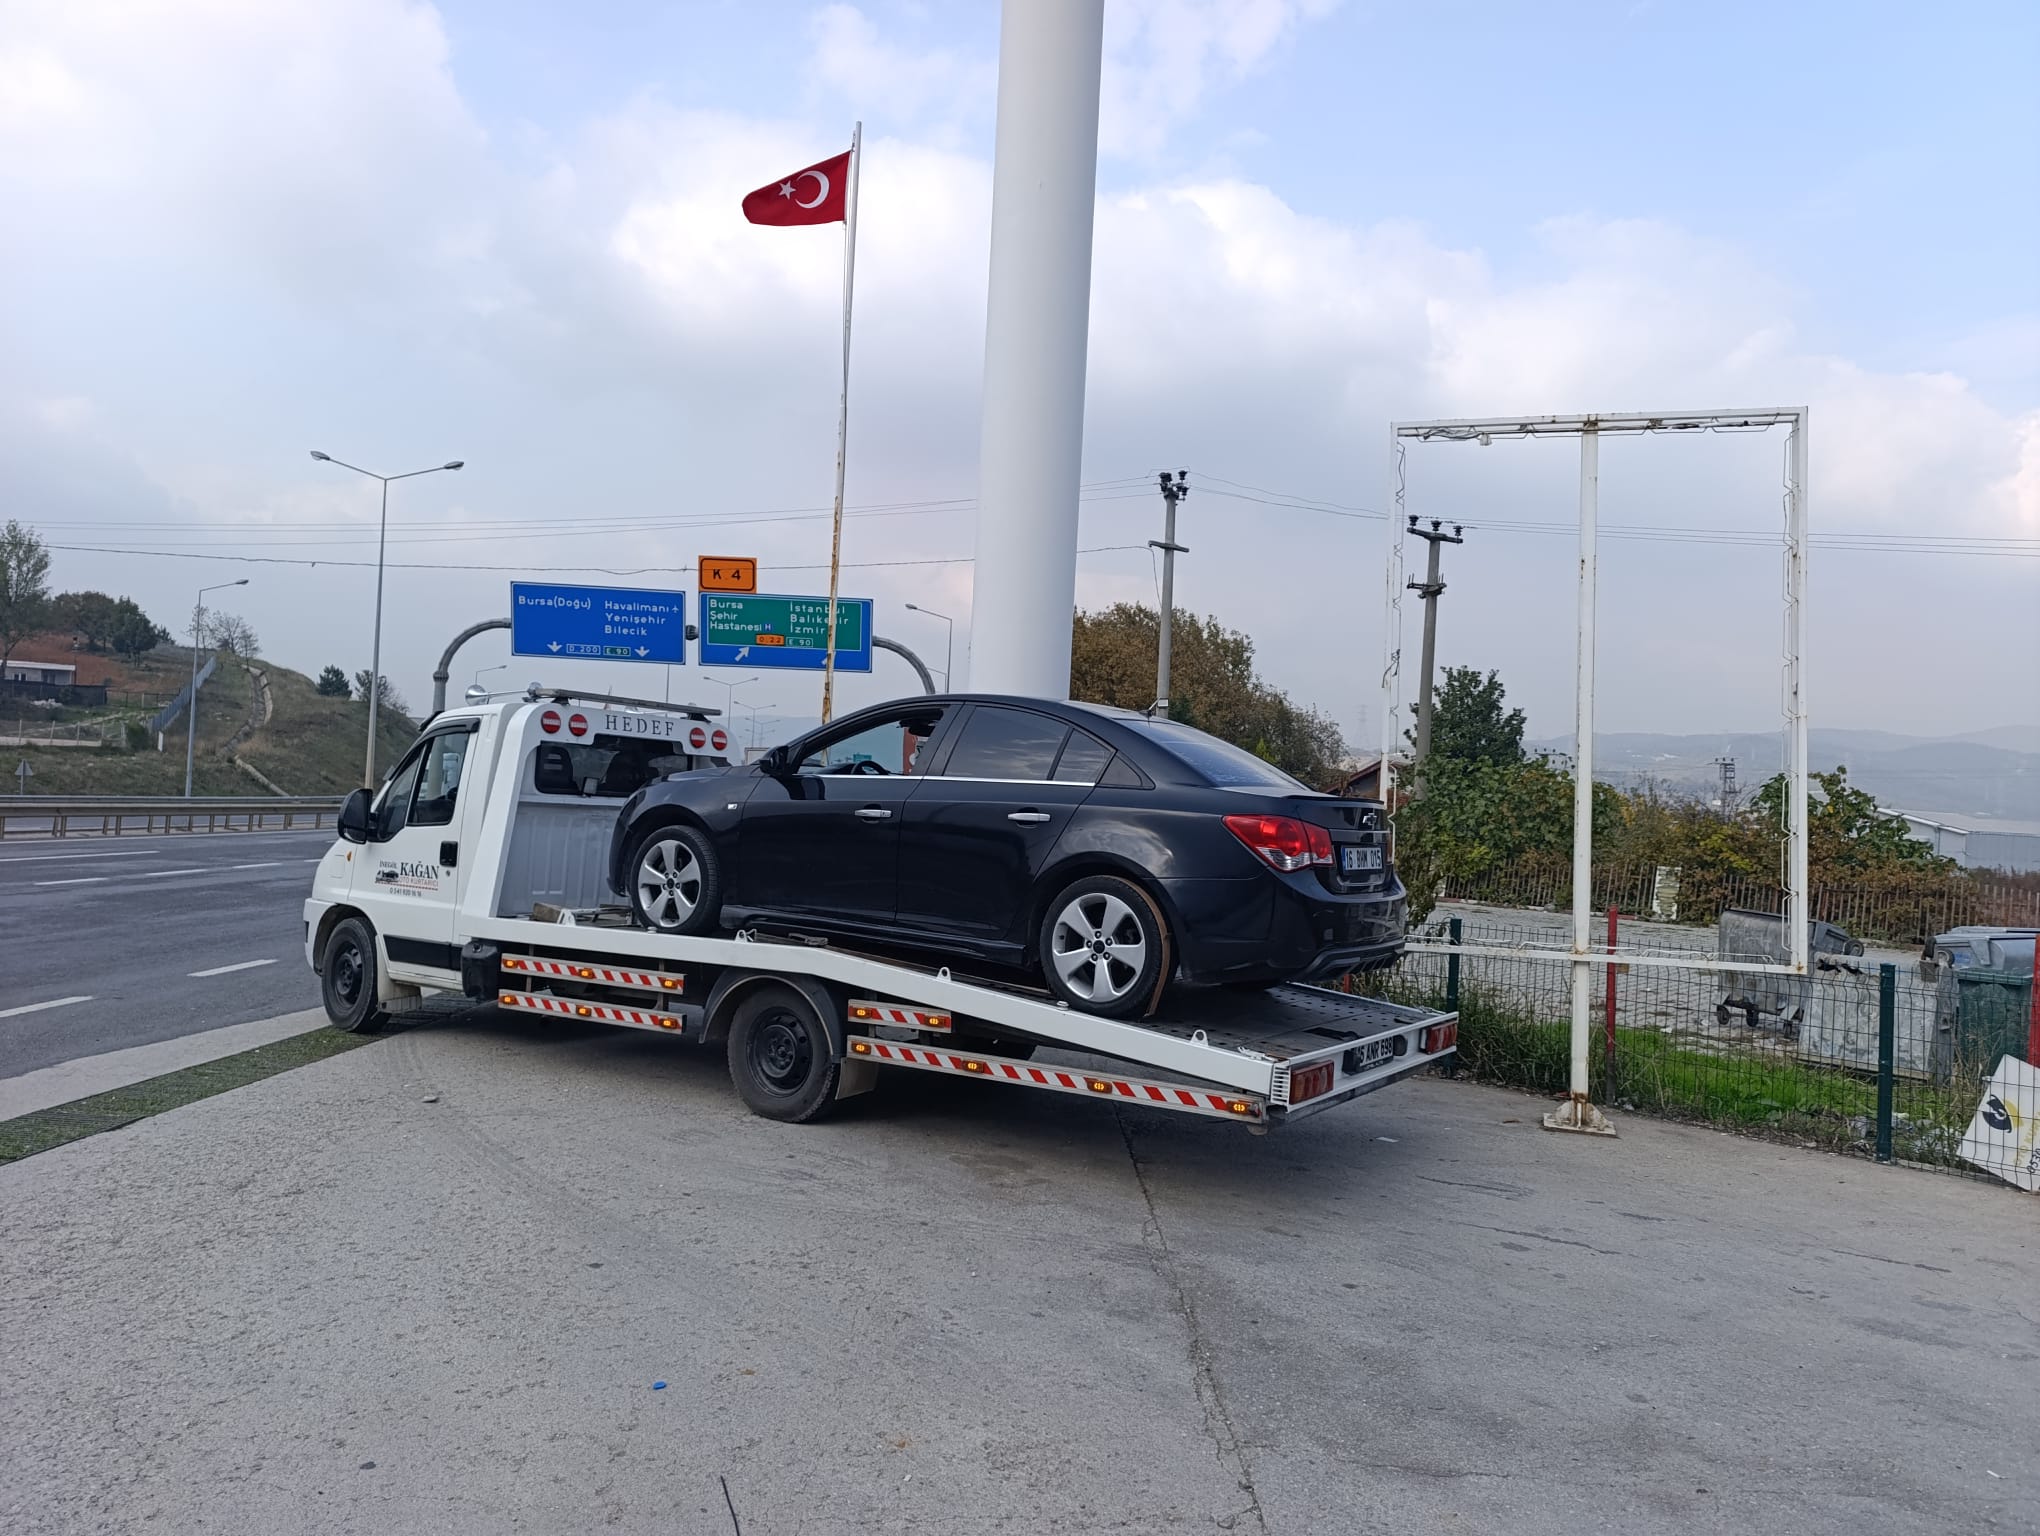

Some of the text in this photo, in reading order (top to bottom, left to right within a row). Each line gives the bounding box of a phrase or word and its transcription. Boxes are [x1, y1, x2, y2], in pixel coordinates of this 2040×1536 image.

[713, 569, 741, 580] K 4
[604, 600, 669, 613] Havalimanı
[709, 599, 743, 609] Bursa
[605, 613, 666, 625] Yenişehir
[710, 610, 738, 621] Şehir
[790, 613, 849, 625] Balıkeir
[604, 625, 647, 636] Bilecik
[709, 621, 762, 631] Hastanesi
[790, 622, 826, 634] İzmir
[605, 714, 675, 736] HEDEF
[1346, 850, 1353, 868] 16
[1370, 849, 1381, 868] 015
[400, 861, 440, 880] KAĞAN
[1365, 1040, 1379, 1061] ANR
[1380, 1036, 1393, 1057] 698
